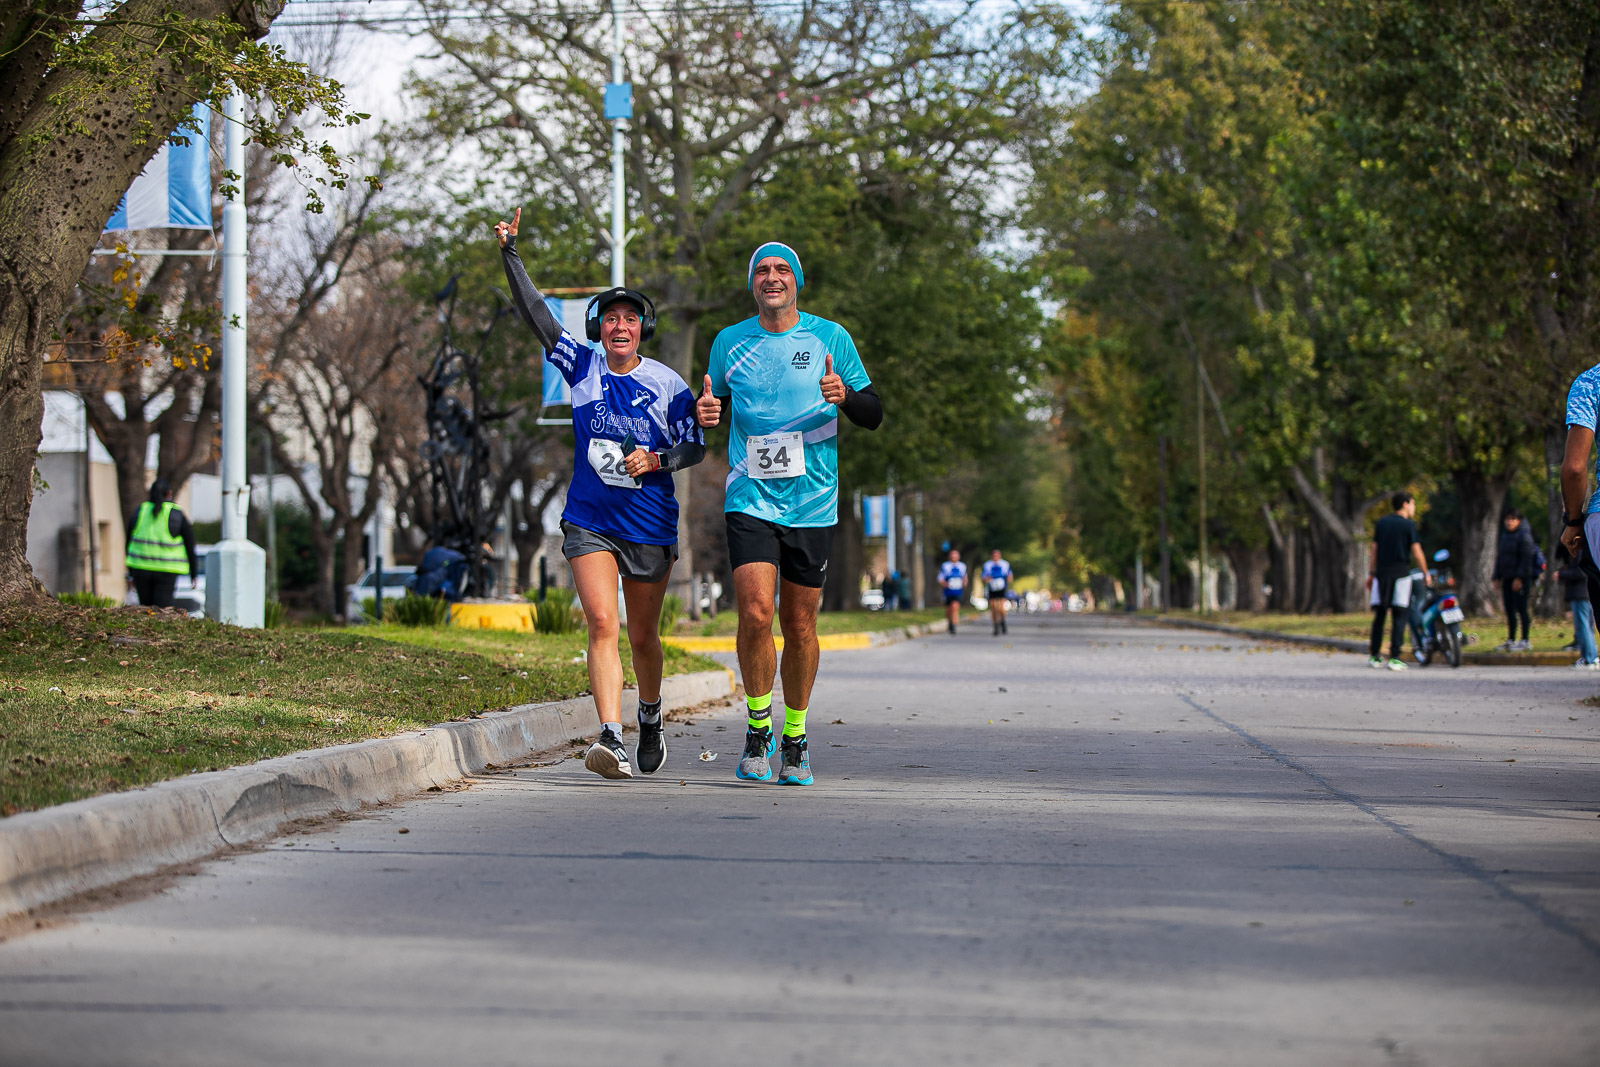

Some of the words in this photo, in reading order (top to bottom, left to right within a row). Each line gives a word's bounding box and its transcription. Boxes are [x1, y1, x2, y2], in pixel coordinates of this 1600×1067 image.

[792, 351, 810, 361] AG
[591, 402, 608, 433] 3
[600, 452, 628, 476] 26
[757, 446, 791, 469] 34
